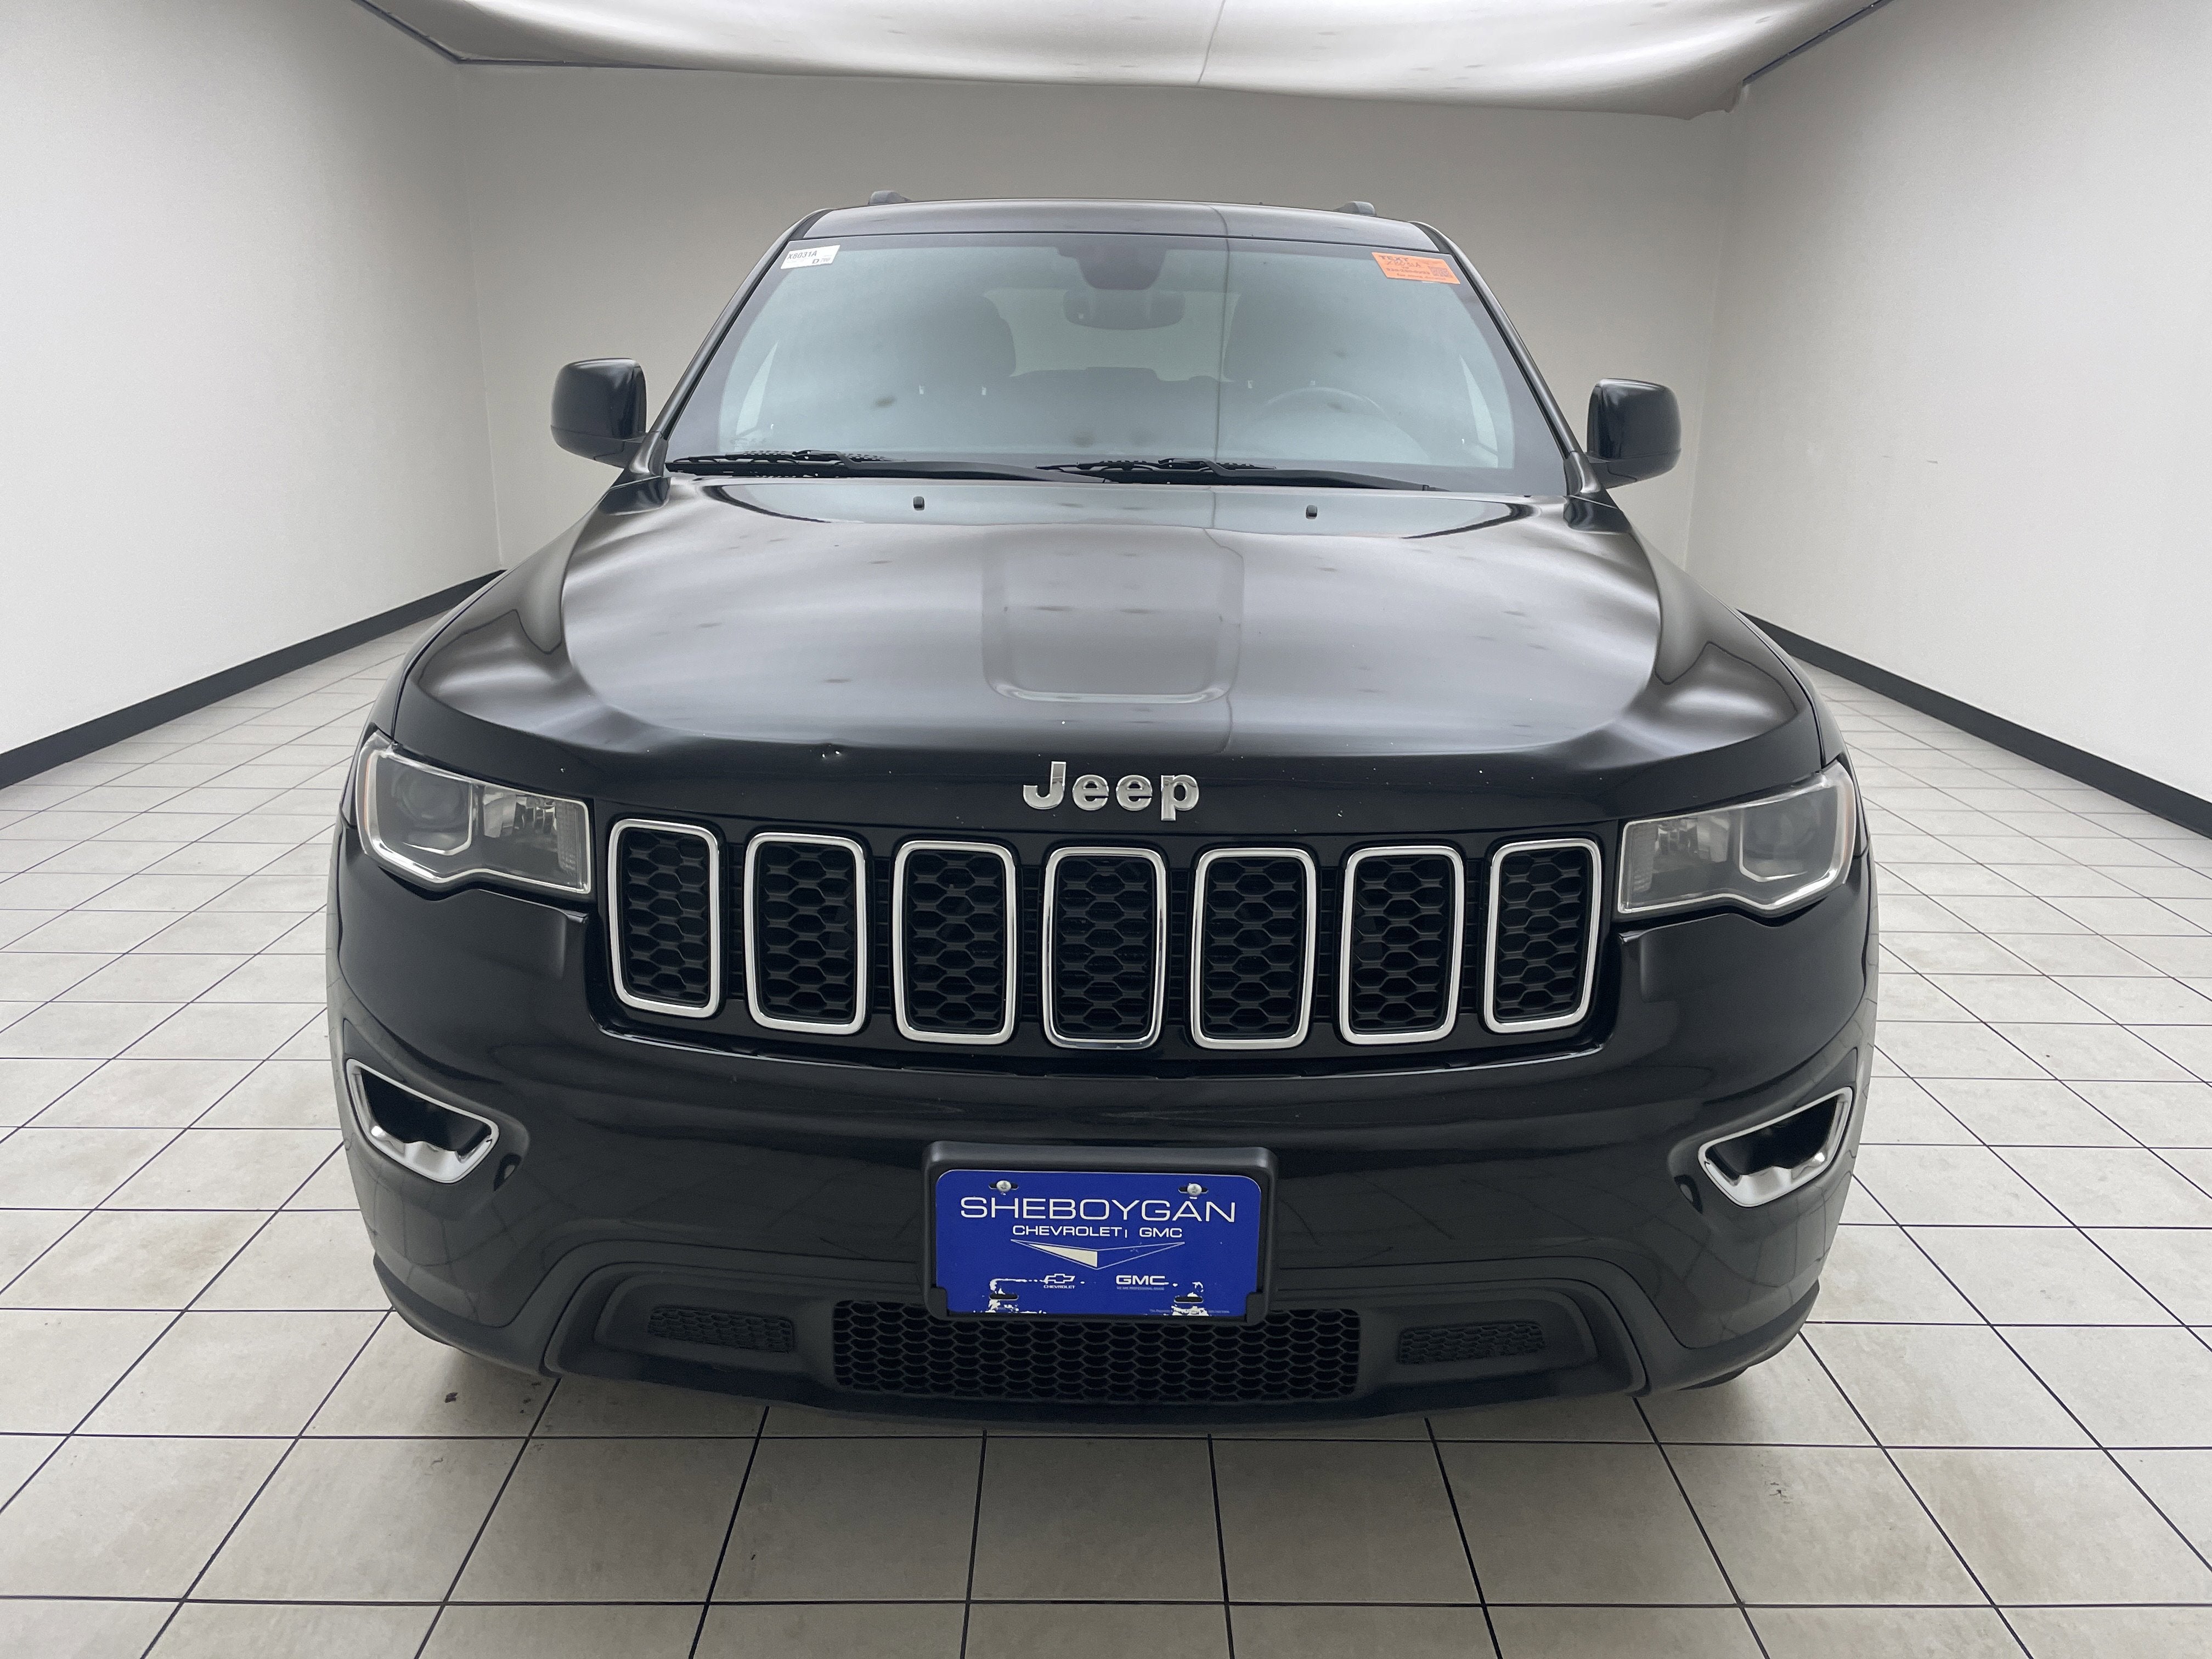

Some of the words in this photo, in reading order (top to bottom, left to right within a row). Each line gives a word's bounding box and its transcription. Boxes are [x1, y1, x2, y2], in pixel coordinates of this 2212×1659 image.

[787, 250, 817, 259] X8031A
[1023, 760, 1199, 821] Jeep
[960, 1196, 1235, 1222] SHEBOYGAN
[1012, 1224, 1123, 1238] CHEVROLET
[1139, 1227, 1183, 1238] GMC
[1116, 1274, 1165, 1285] GMC
